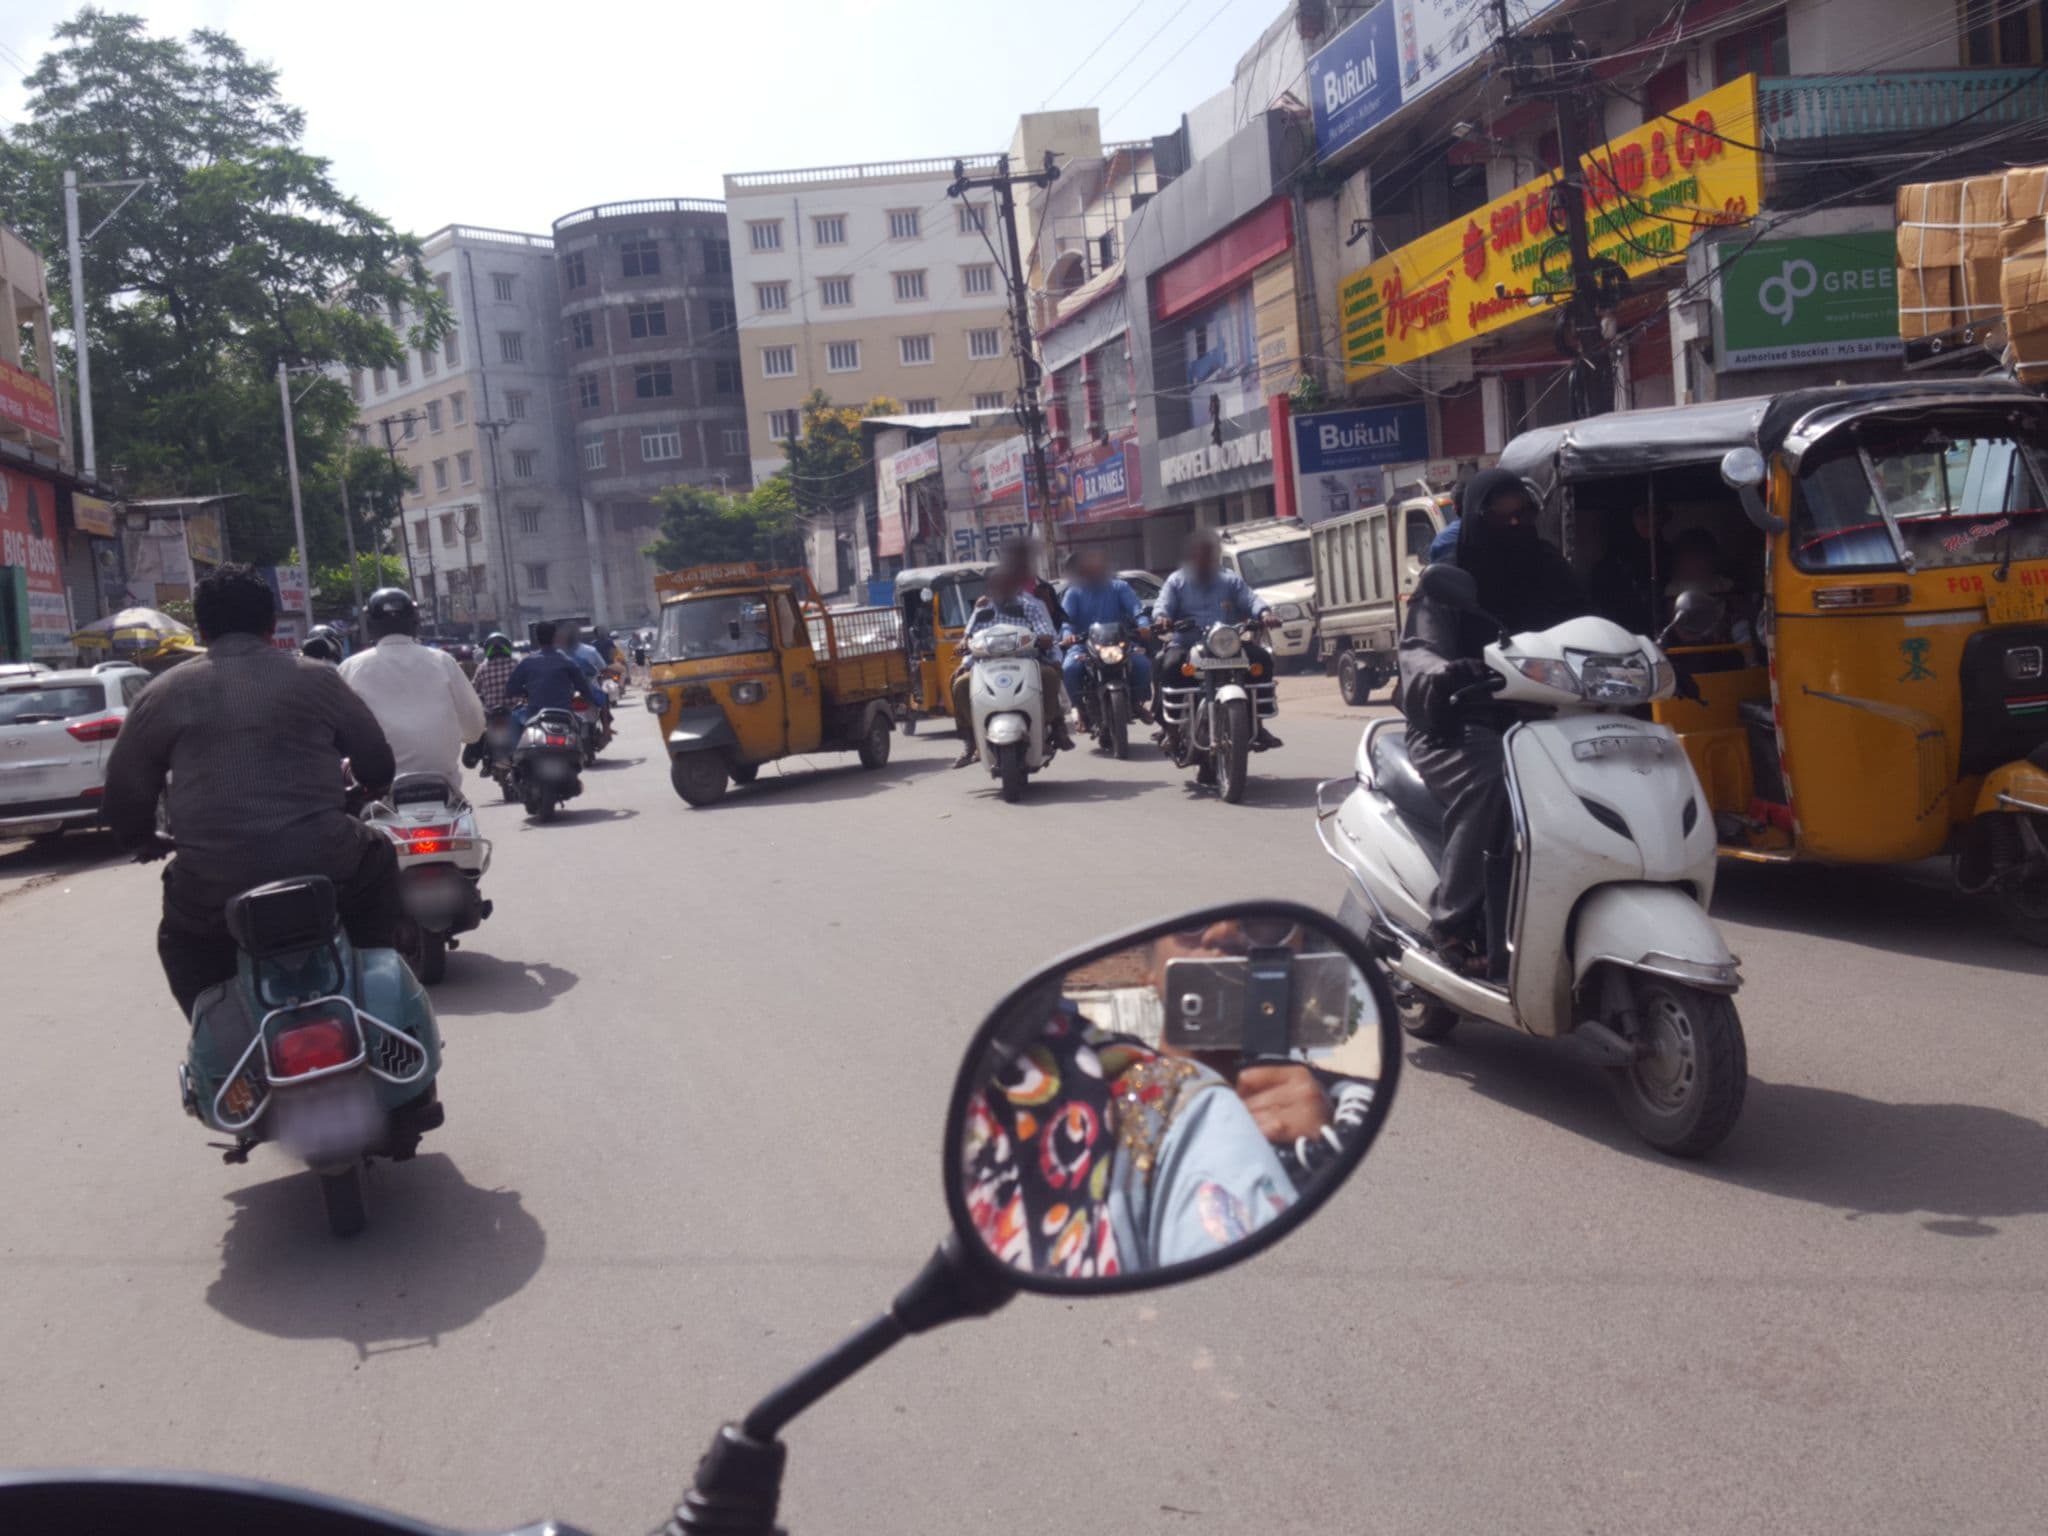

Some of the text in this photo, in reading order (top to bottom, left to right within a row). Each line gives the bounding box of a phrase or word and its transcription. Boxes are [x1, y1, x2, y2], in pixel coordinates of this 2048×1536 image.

[1651, 130, 1671, 180] &
[1735, 351, 1788, 364] Authorised
[1791, 347, 1829, 360] Stockist
[1208, 429, 1273, 474] MODULA
[3, 528, 57, 577] BIG BOSS
[1947, 574, 1985, 593] FOR
